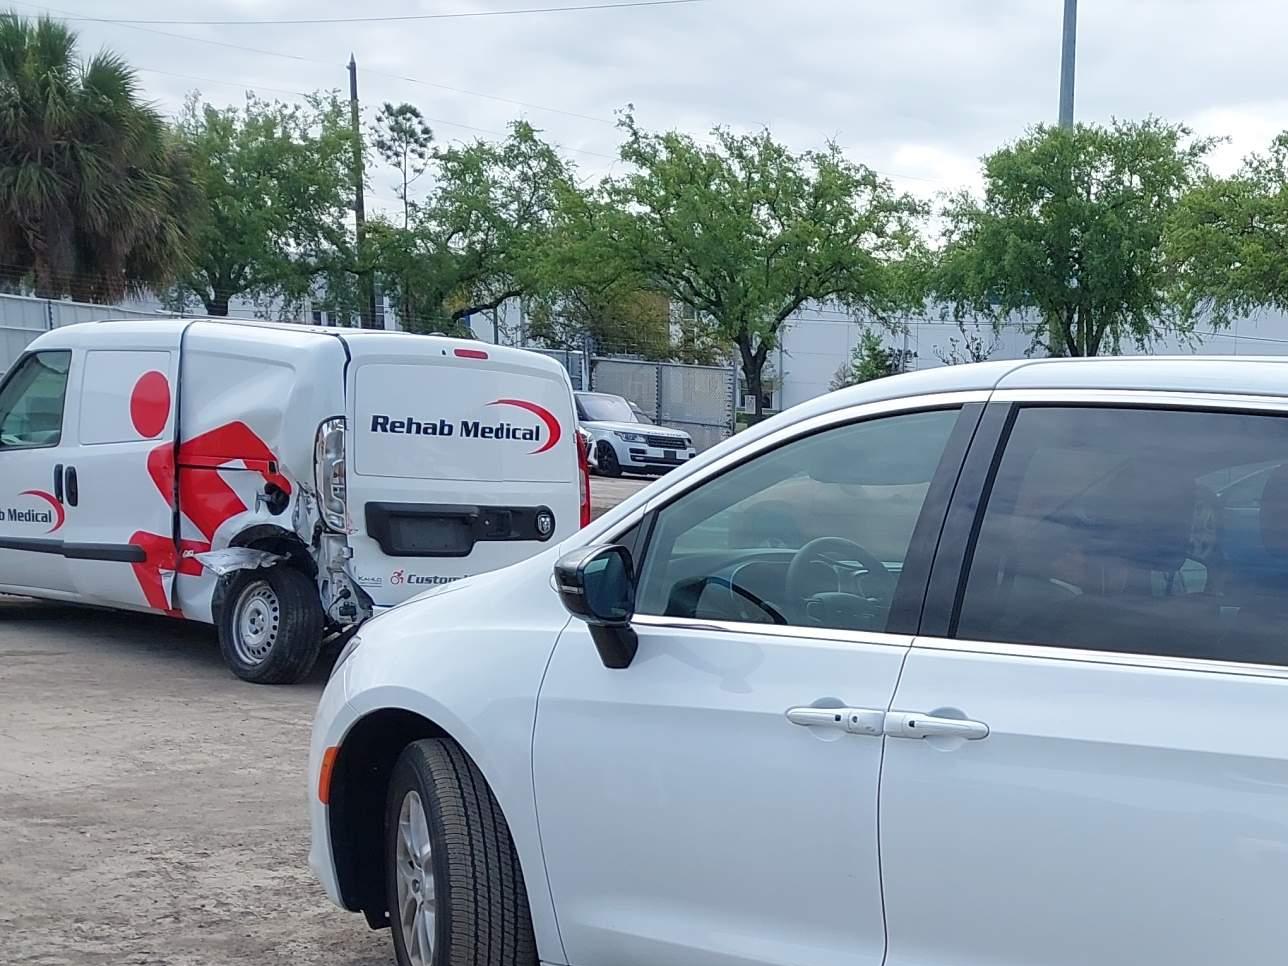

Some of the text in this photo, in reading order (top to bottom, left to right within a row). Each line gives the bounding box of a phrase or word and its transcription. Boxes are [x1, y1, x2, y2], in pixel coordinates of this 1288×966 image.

[371, 415, 540, 441] Rehab Medical
[7, 508, 52, 523] Medical
